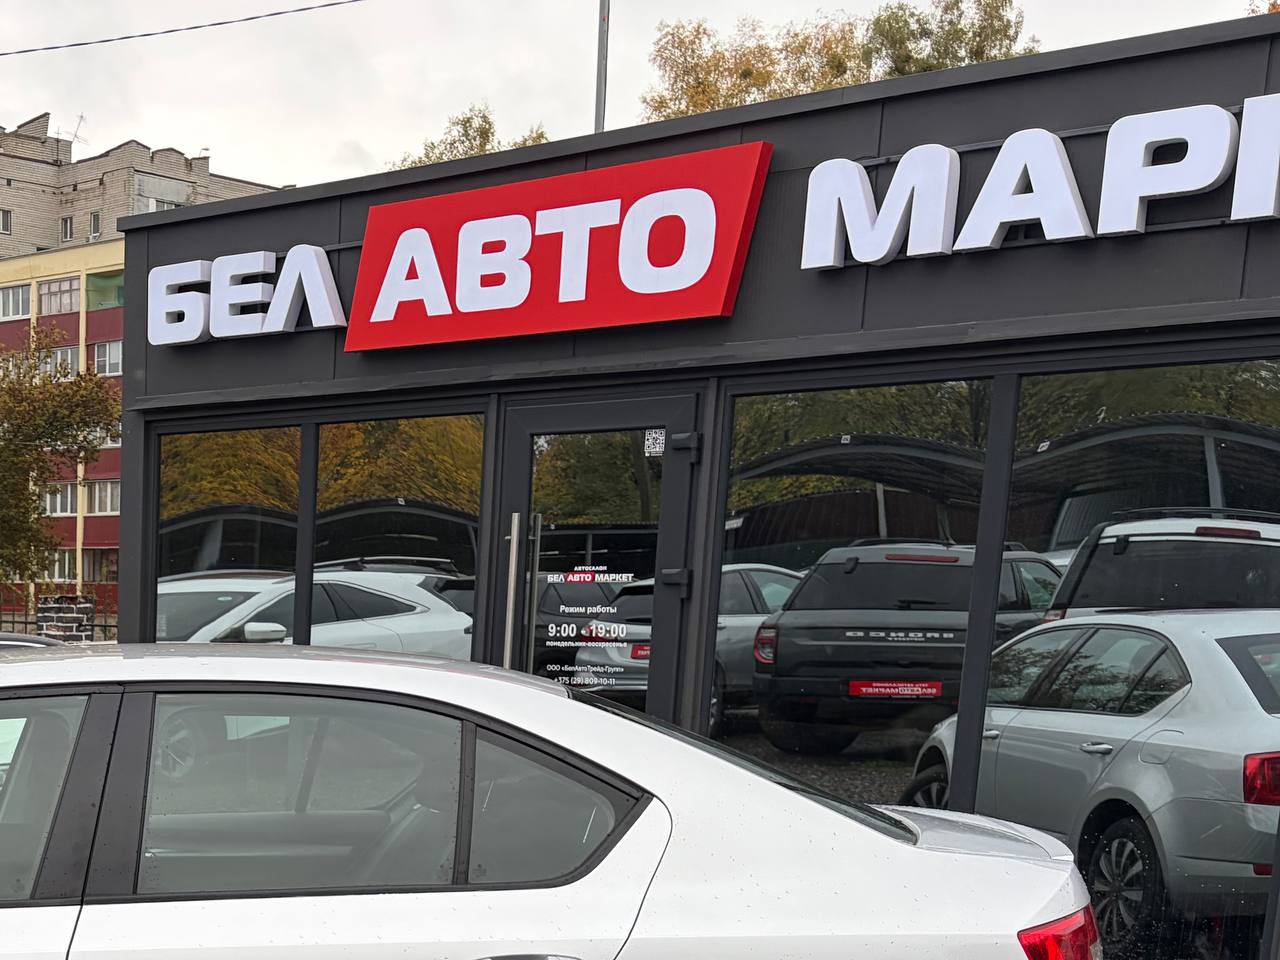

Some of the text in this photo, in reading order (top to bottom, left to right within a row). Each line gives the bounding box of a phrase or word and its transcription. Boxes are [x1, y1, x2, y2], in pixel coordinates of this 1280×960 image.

[148, 244, 347, 346] БЕЛ
[369, 187, 717, 323] АВТО
[547, 573, 634, 583] БЕЛ АВТО МАРКЕТ
[559, 605, 617, 614] Режим работы
[548, 624, 577, 637] 9:00
[590, 624, 627, 638] 19:00
[570, 677, 583, 685] (29)
[584, 677, 616, 685] 809-10-11
